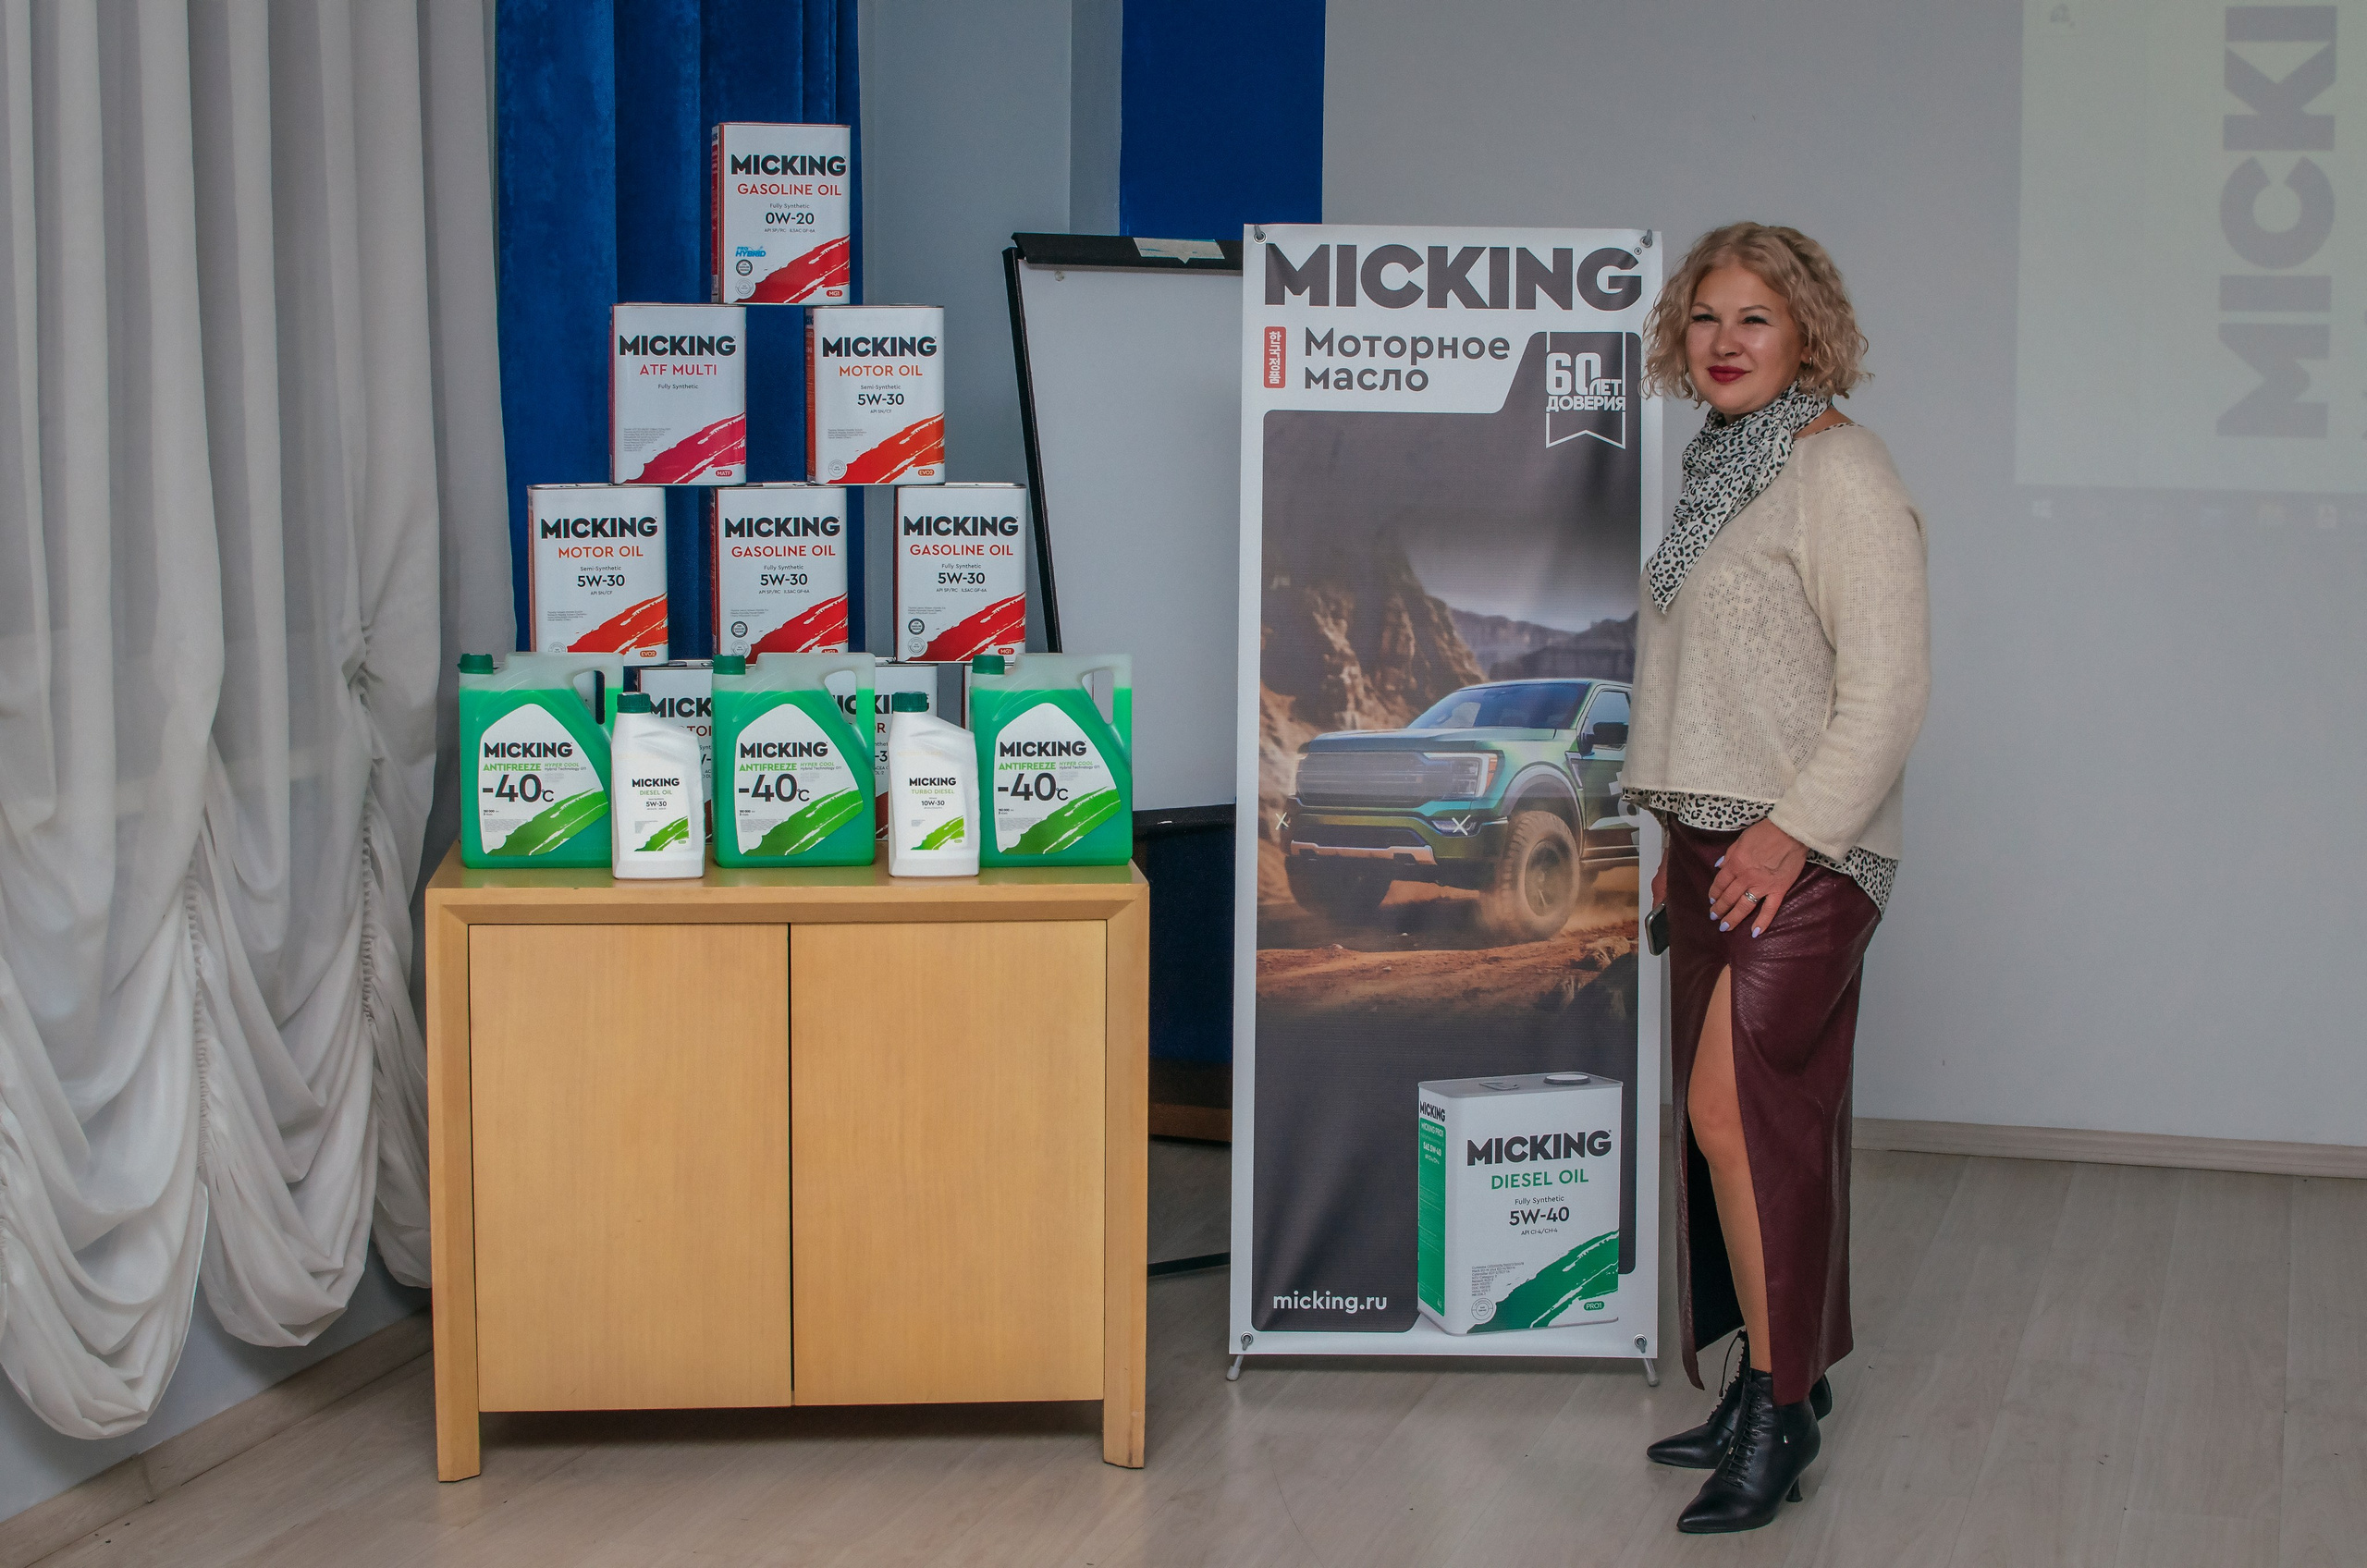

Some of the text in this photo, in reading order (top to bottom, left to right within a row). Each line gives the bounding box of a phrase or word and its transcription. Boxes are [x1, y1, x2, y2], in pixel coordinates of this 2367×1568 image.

[730, 154, 846, 177] MICKING
[737, 183, 841, 196] GASOLINE OIL
[766, 212, 815, 225] 0W-20
[1265, 243, 1642, 311] MICKING
[619, 335, 736, 356] MICKING
[822, 337, 938, 357] MICKING
[1305, 327, 1510, 366] Моторное
[1269, 331, 1282, 385] 한국정품
[640, 364, 717, 375] ATF MULTI
[839, 365, 923, 376] MOTOR OIL
[1546, 352, 1622, 396] 60 ЛЕТ
[1305, 366, 1429, 392] масло
[857, 393, 904, 405] 5W-30
[1546, 396, 1625, 412] ДОВЕРИЯ
[541, 517, 657, 539] MICKING
[725, 517, 840, 538] MICKING
[903, 516, 1018, 536] MICKING
[558, 545, 644, 558] MOTOR OIL
[731, 545, 836, 557] GASOLINE OIL
[910, 544, 1013, 556] GASOLINE OIL
[577, 575, 625, 587] 5W-30
[760, 573, 808, 585] 5W-30
[938, 572, 986, 584] 5W-30
[650, 697, 711, 718] MICK
[484, 742, 573, 758] MICKING
[740, 741, 828, 758] MICKING
[1000, 741, 1087, 757] MICKING
[483, 763, 542, 771] ANTIFREEZE
[739, 763, 798, 771] ANTIFREEZE
[998, 762, 1056, 770] ANTIFREEZE
[632, 778, 681, 788] MICKING
[909, 777, 957, 786] MICKING
[1420, 1100, 1446, 1122] MICKING
[1467, 1130, 1612, 1167] MICKING
[1491, 1169, 1589, 1190] DIESEL OIL
[1515, 1194, 1564, 1206] Fully Synthetic
[1509, 1206, 1570, 1226] 5W-40
[1273, 1290, 1387, 1314] micking.ru
